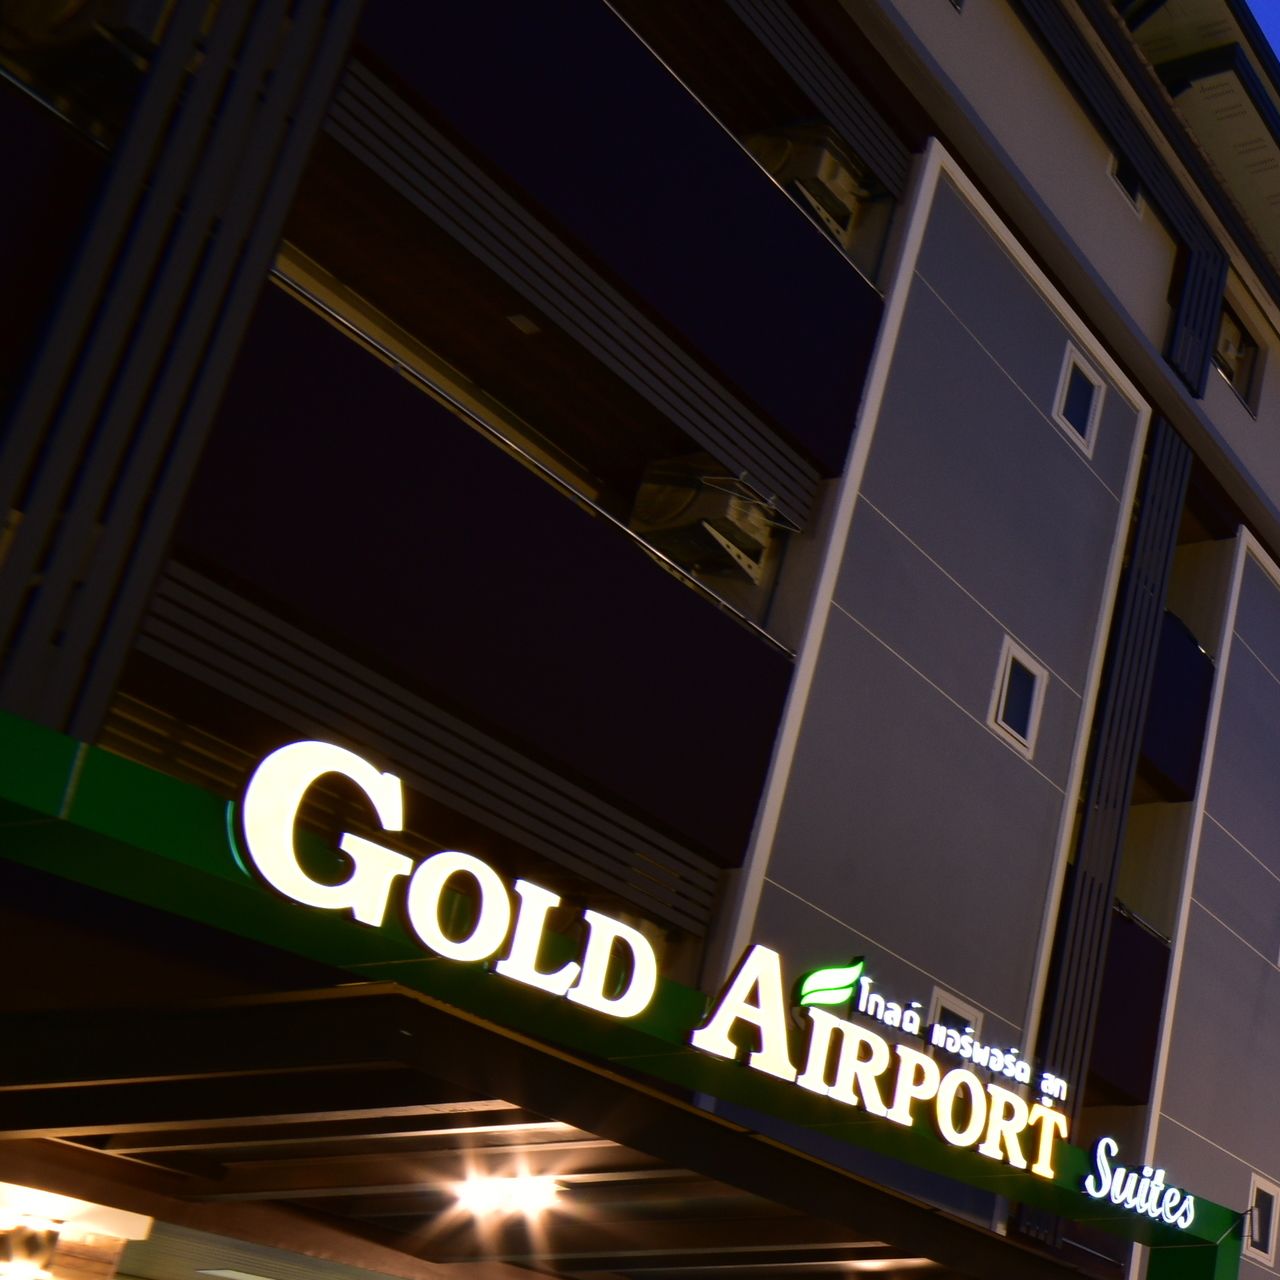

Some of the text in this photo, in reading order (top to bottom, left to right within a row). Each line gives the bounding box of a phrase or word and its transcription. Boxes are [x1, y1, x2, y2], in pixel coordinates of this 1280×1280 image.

[242, 740, 1195, 1229] GOLD AIRPORT Suites
[857, 975, 924, 1036] โกลด์
